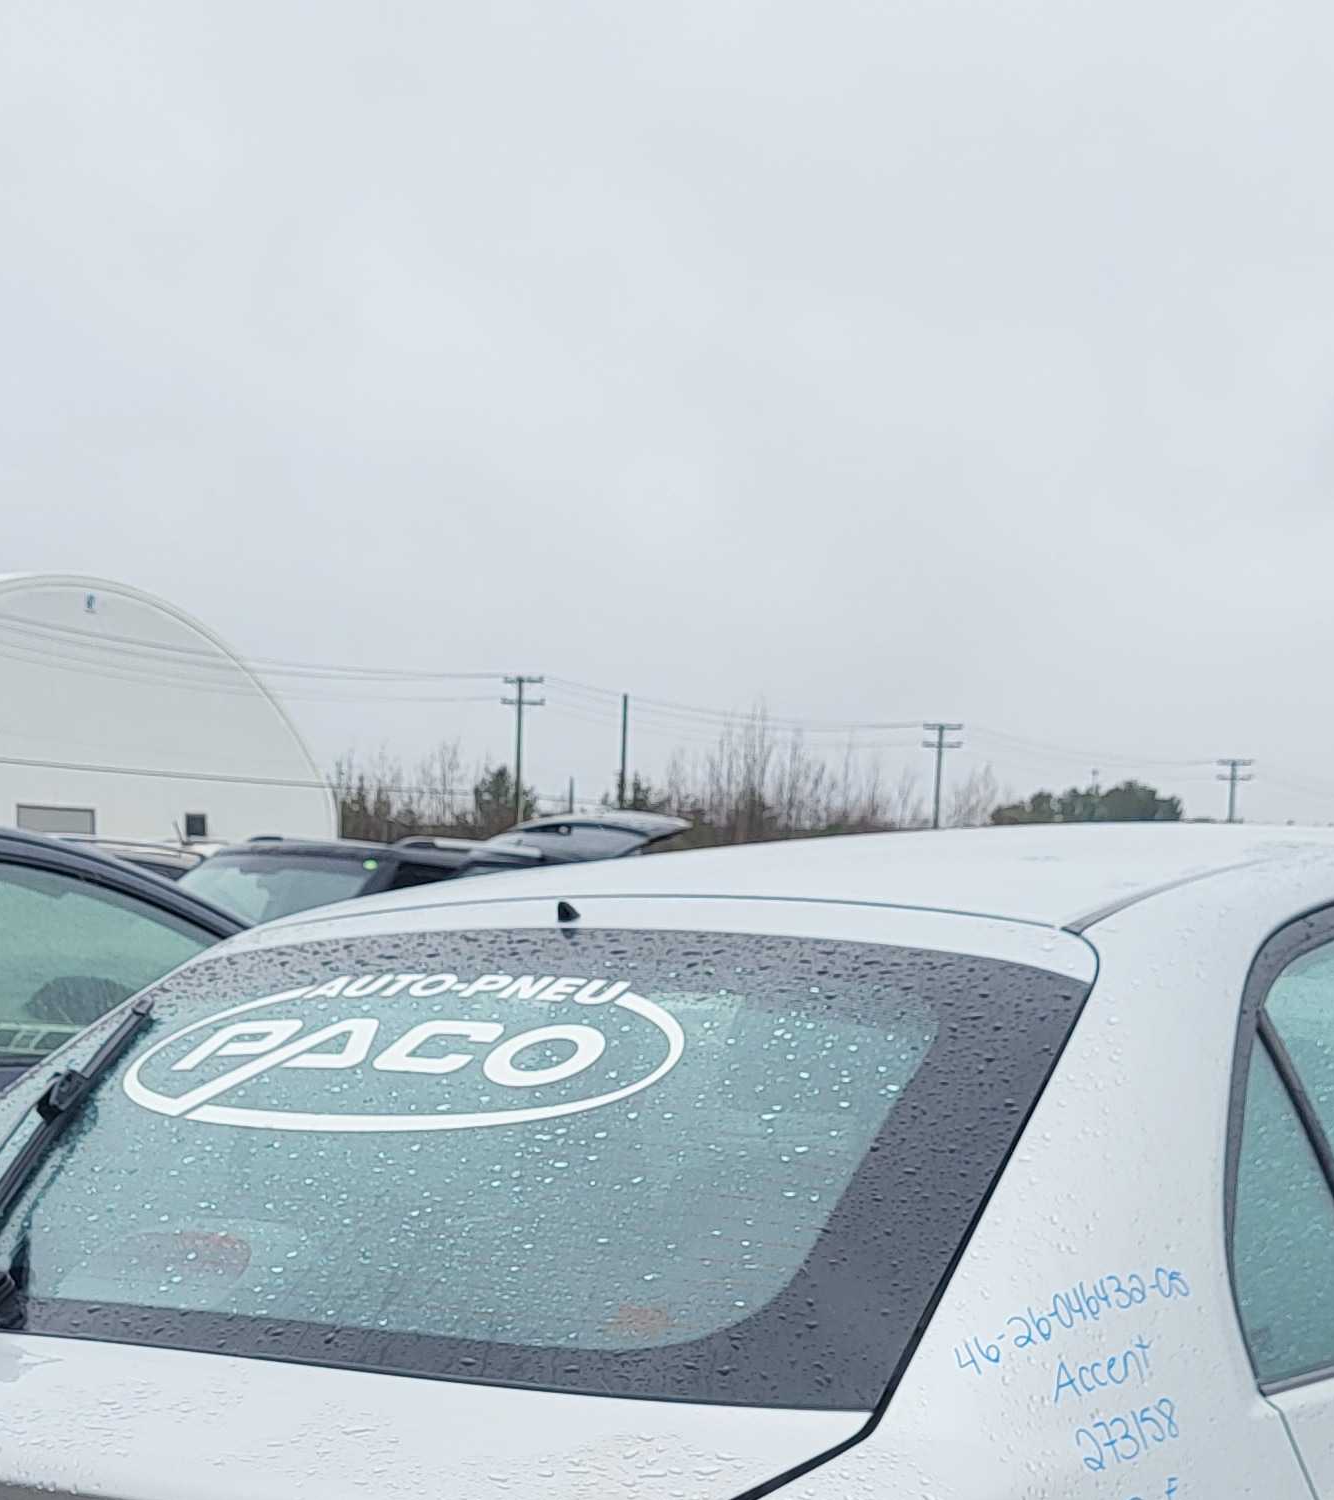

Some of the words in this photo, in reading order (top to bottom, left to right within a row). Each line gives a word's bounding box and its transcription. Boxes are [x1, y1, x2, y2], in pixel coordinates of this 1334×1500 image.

[307, 972, 631, 1006] AUTO-PNEU
[170, 1018, 607, 1088] PACO
[1053, 1335, 1152, 1403] Accent
[1075, 1397, 1181, 1472] 273158
